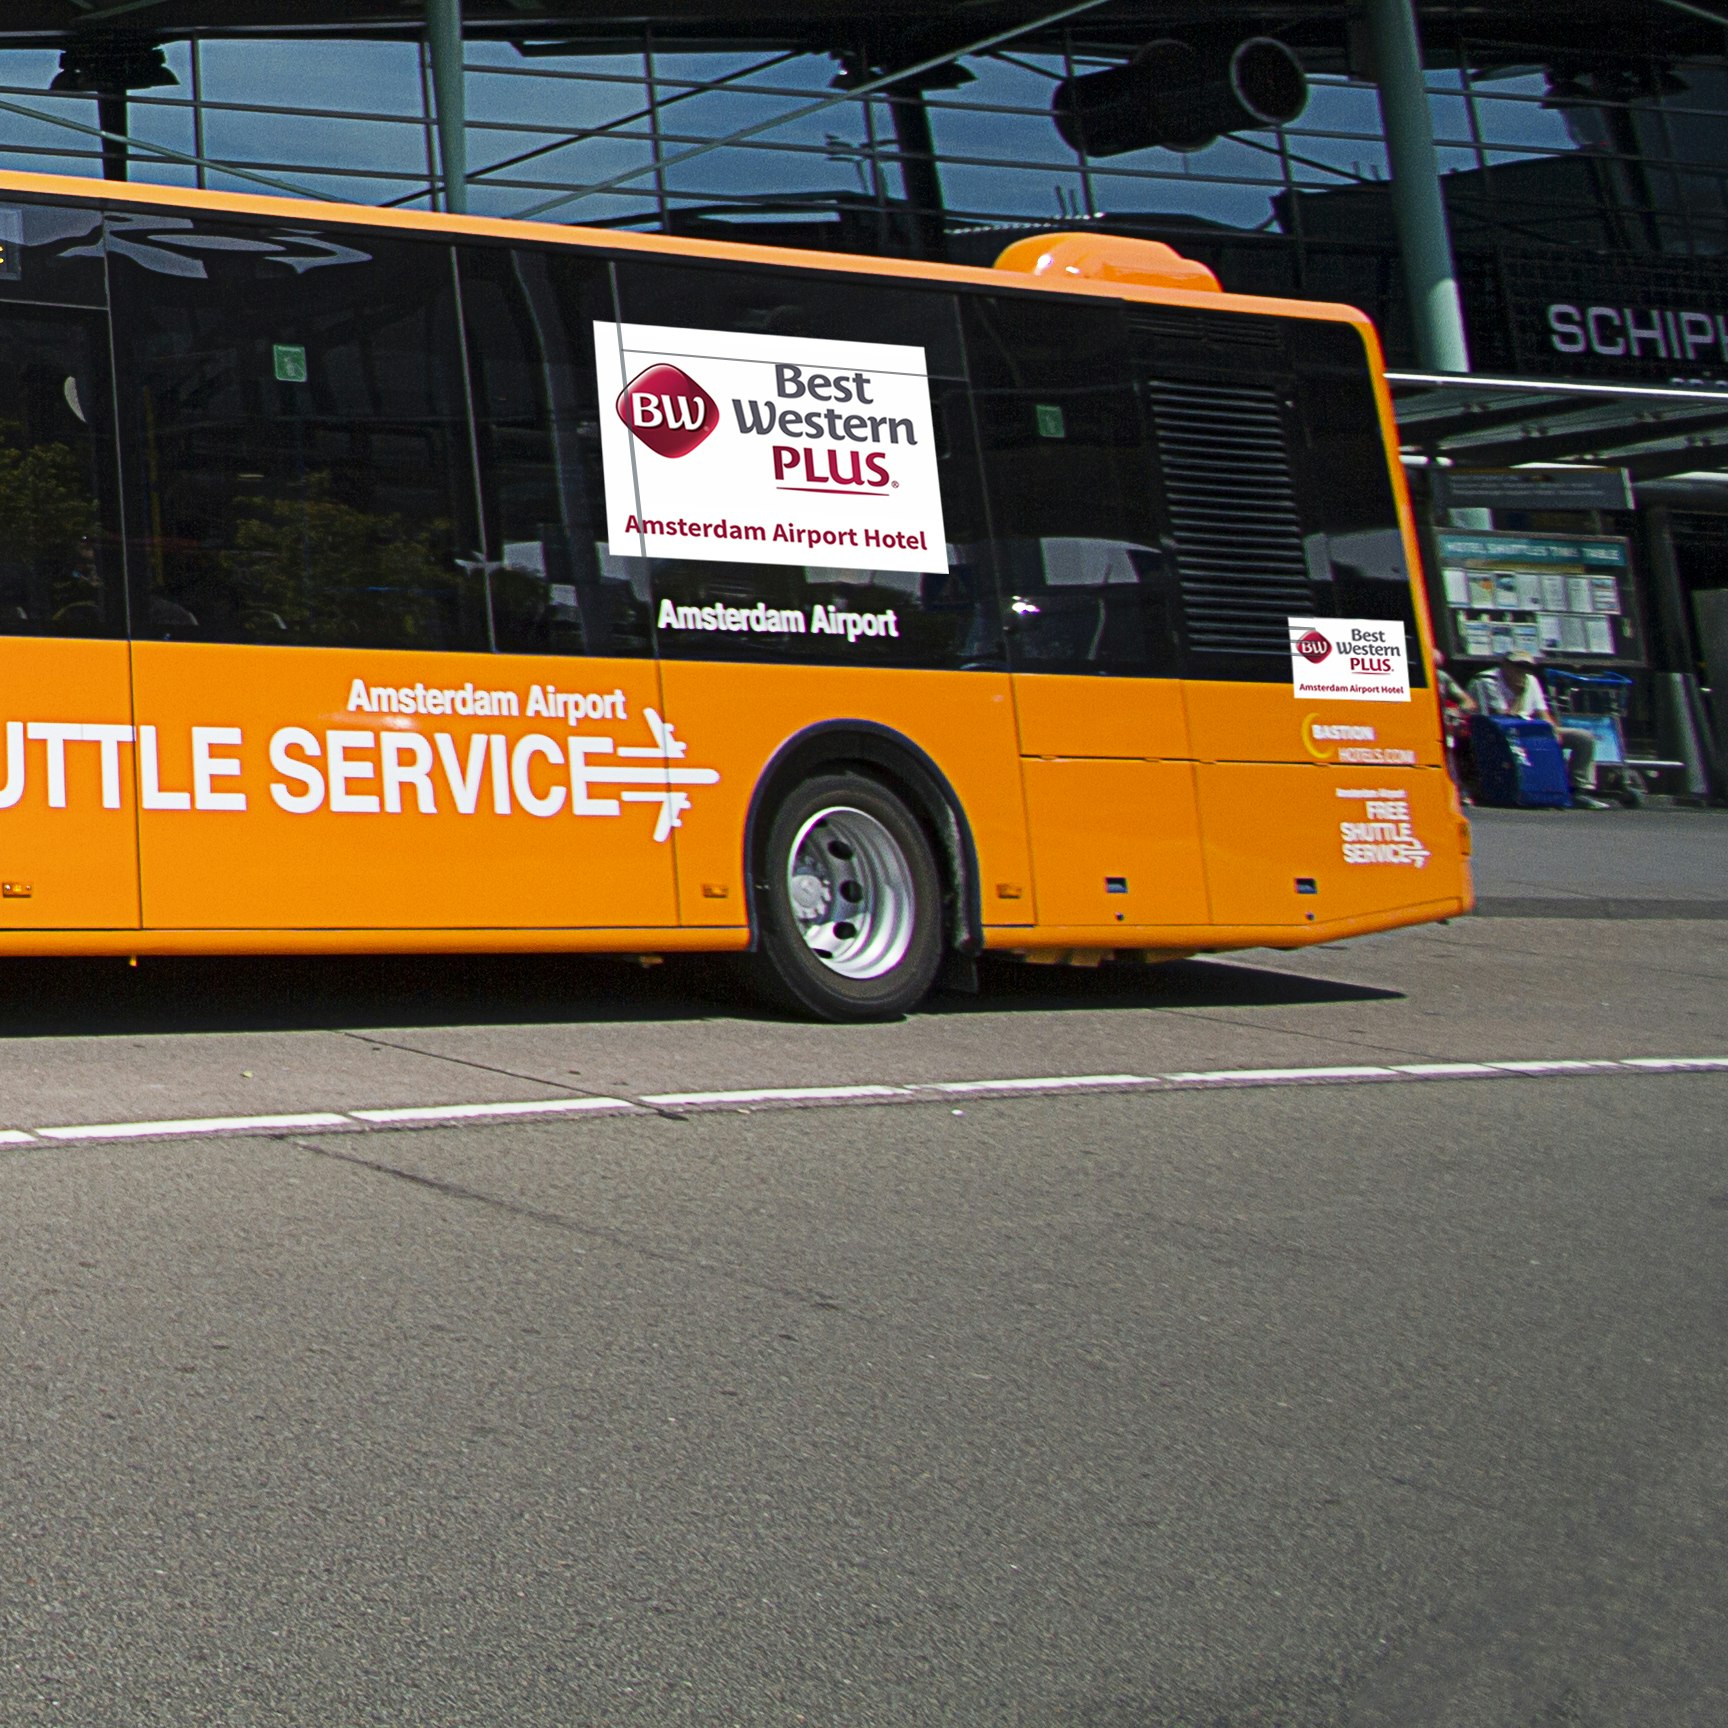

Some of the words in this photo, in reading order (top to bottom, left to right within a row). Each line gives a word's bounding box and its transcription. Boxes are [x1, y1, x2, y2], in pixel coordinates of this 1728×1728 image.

[775, 363, 874, 404] Best
[630, 391, 707, 432] BW
[731, 398, 918, 445] Western
[772, 445, 890, 488] PLUS
[624, 514, 767, 542] Amsterdam
[772, 522, 859, 549] Airport
[863, 528, 928, 551] Hotel
[657, 598, 806, 635] Amsterdam
[810, 604, 899, 643] Airport
[1351, 628, 1386, 642] Best
[1301, 640, 1328, 654] BW
[1336, 641, 1401, 657] Western
[1350, 658, 1391, 672] PLUS
[1299, 683, 1348, 693] Amsterdam
[1350, 685, 1380, 695] Airport
[1382, 686, 1404, 694] Hotel
[347, 678, 519, 718] Amsterdam
[525, 684, 627, 726] Airport
[1311, 725, 1376, 741] BASTION
[268, 727, 621, 818] SERVICE
[1366, 801, 1411, 820] FREE
[1340, 822, 1412, 842] SHUTTLE
[1342, 843, 1412, 864] SERVICE
